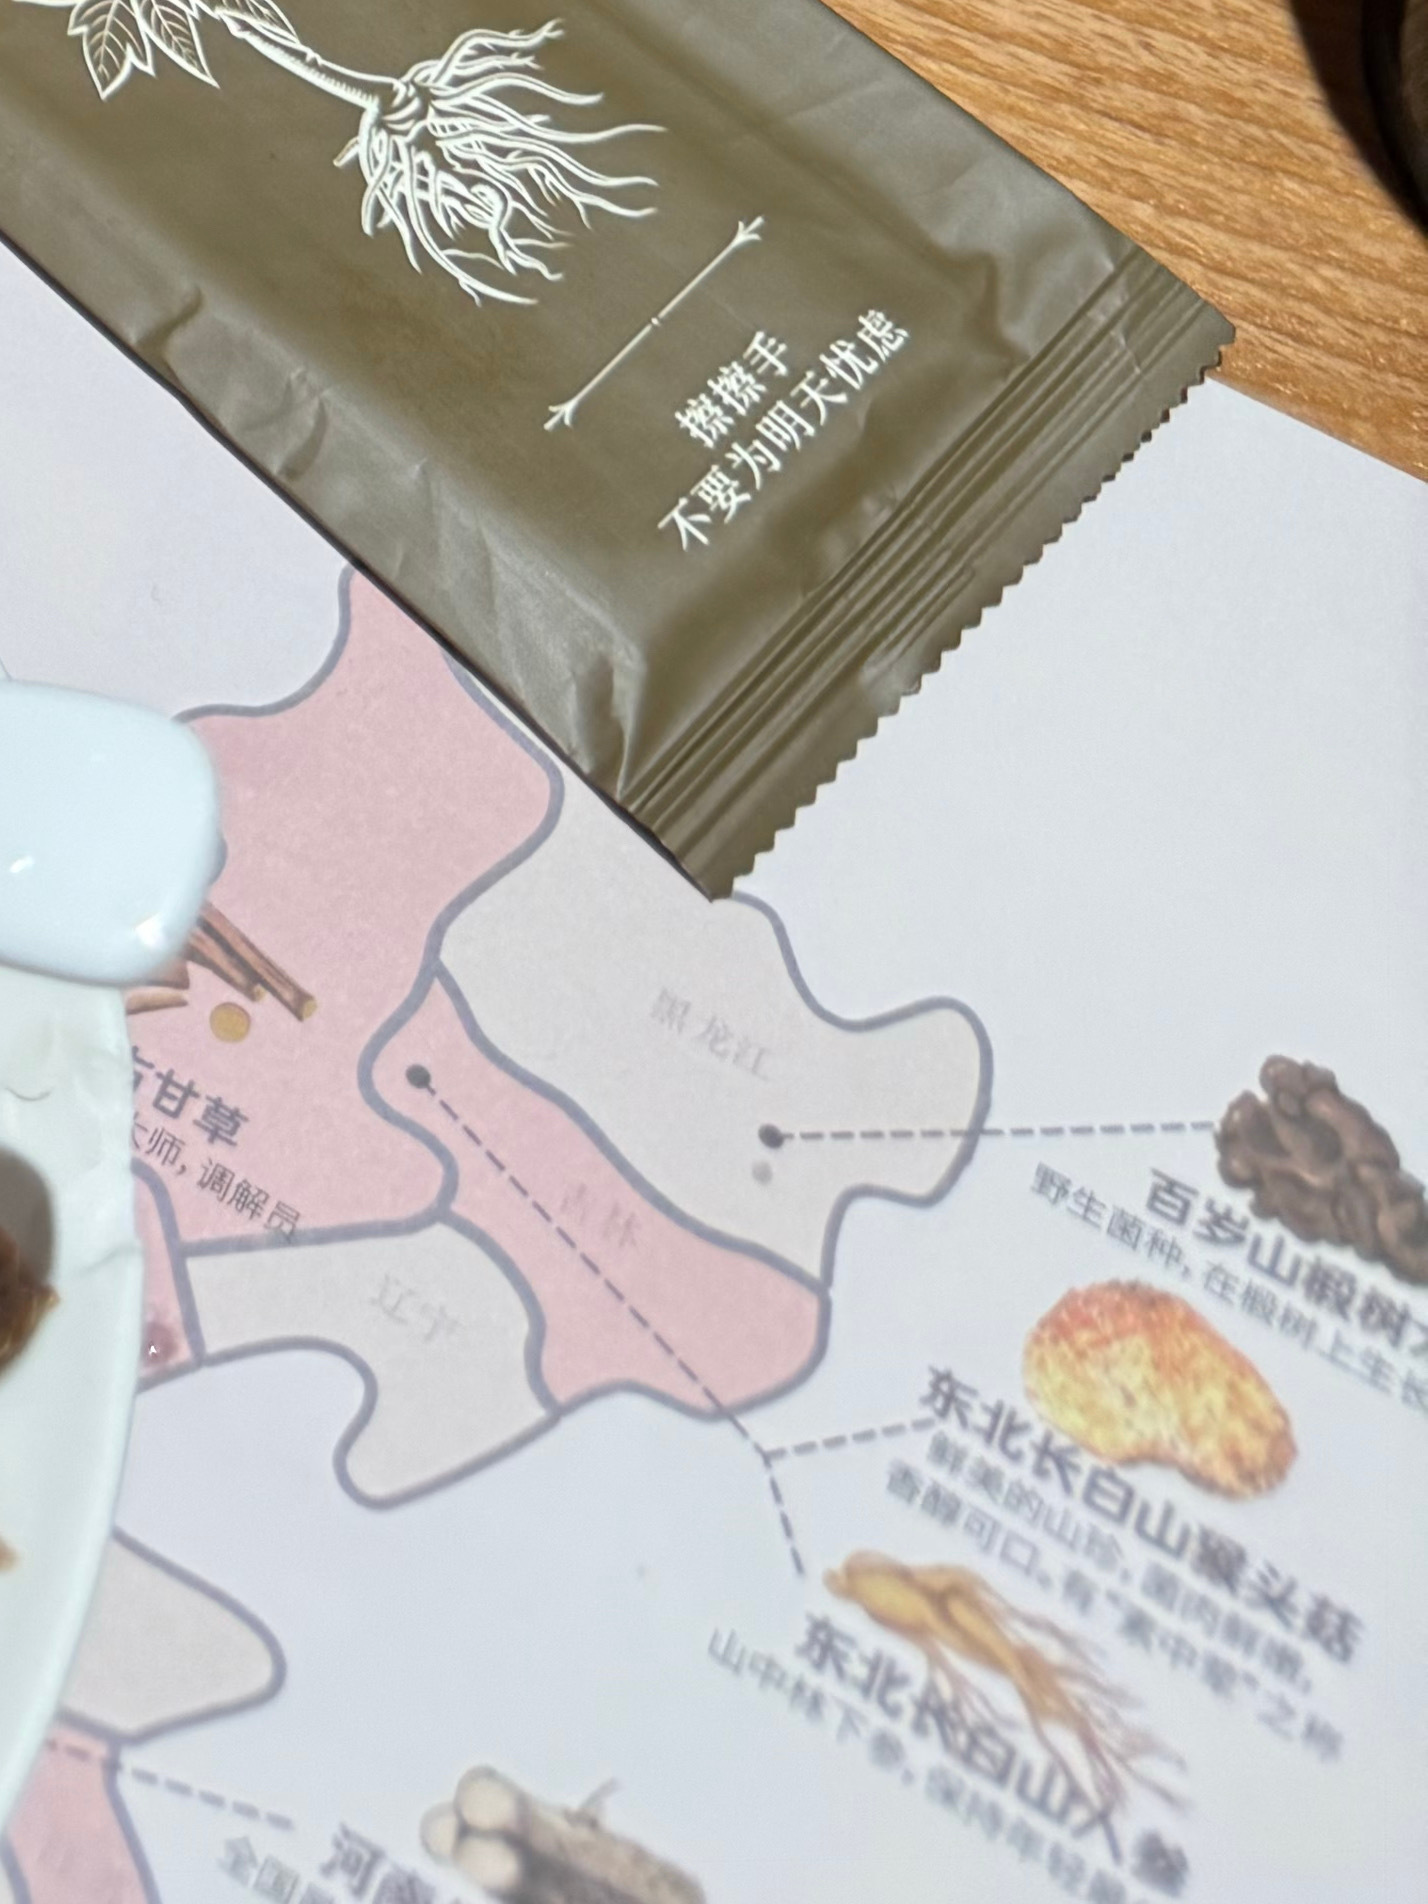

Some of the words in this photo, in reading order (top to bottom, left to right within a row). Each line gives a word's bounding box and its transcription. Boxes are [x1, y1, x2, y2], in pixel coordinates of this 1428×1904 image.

[656, 307, 911, 551] 不要为明天忧虑
[674, 330, 790, 449] 擦擦手
